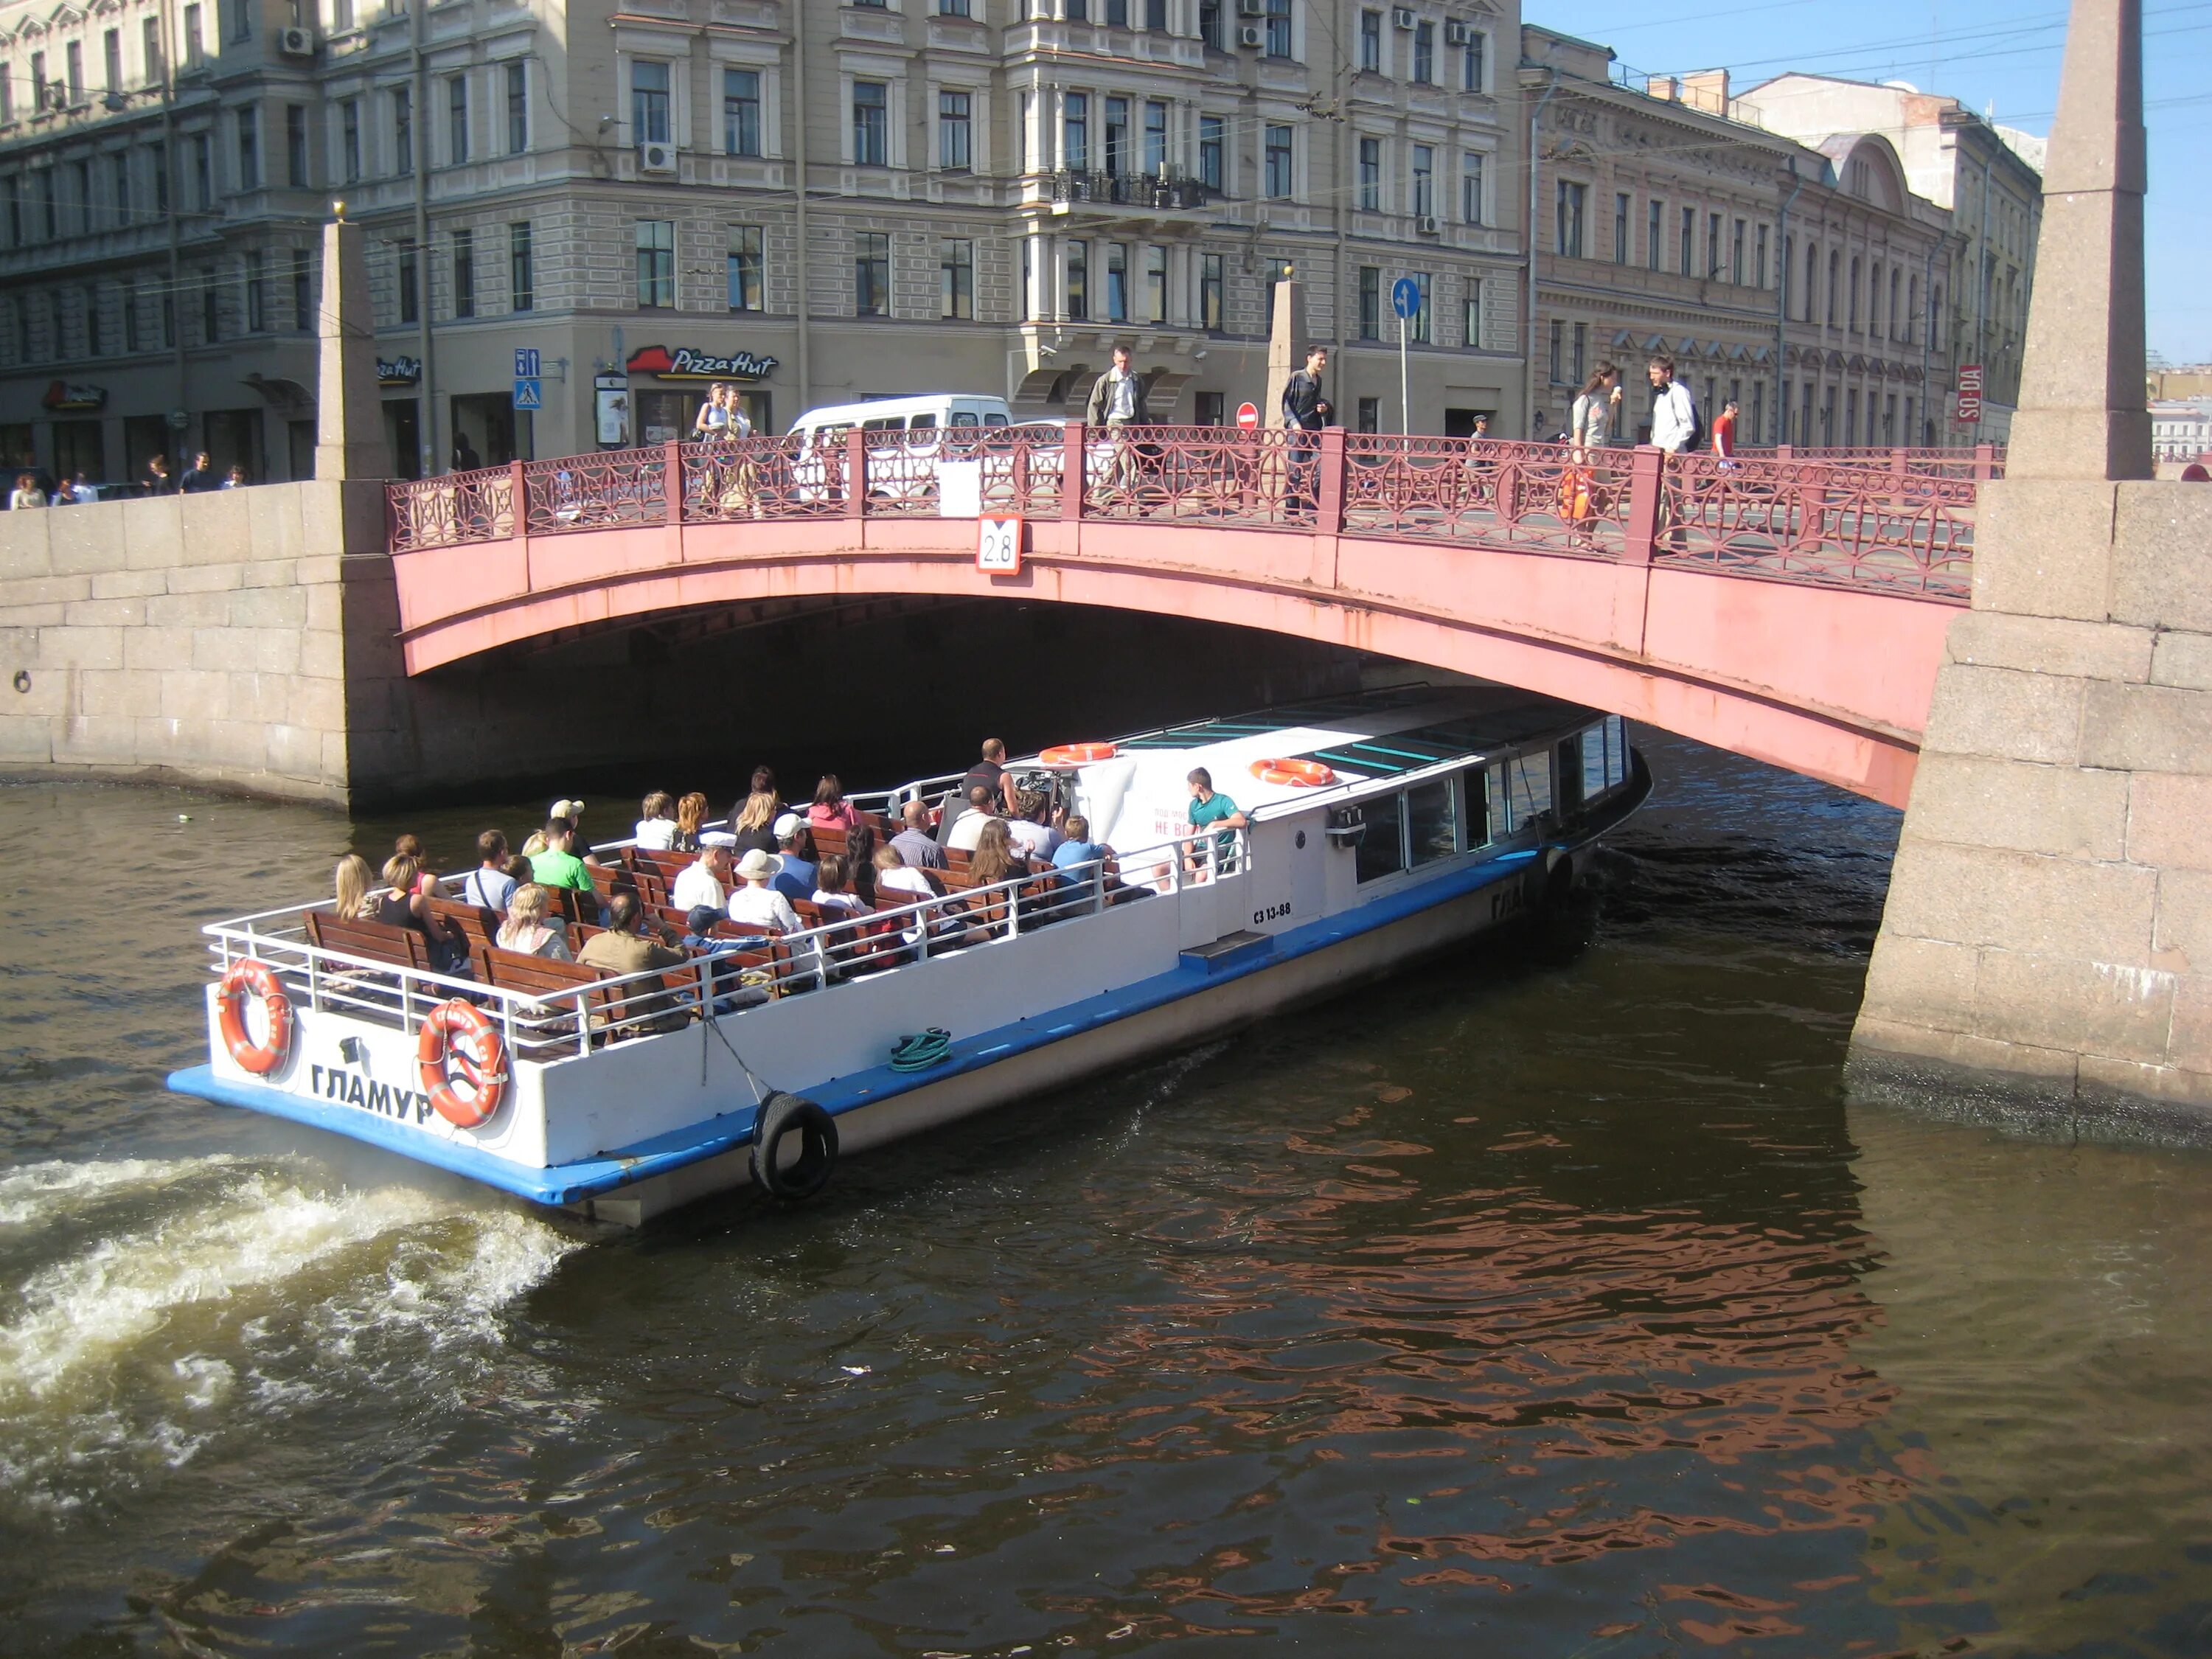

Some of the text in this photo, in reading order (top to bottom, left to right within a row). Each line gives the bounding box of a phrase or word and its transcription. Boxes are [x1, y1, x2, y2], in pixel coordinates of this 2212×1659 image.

[672, 350, 777, 375] Pizza Hut
[1155, 821, 1168, 835] НЕ
[1266, 902, 1291, 921] 13-88
[311, 1064, 434, 1124] ГЛАМУР
